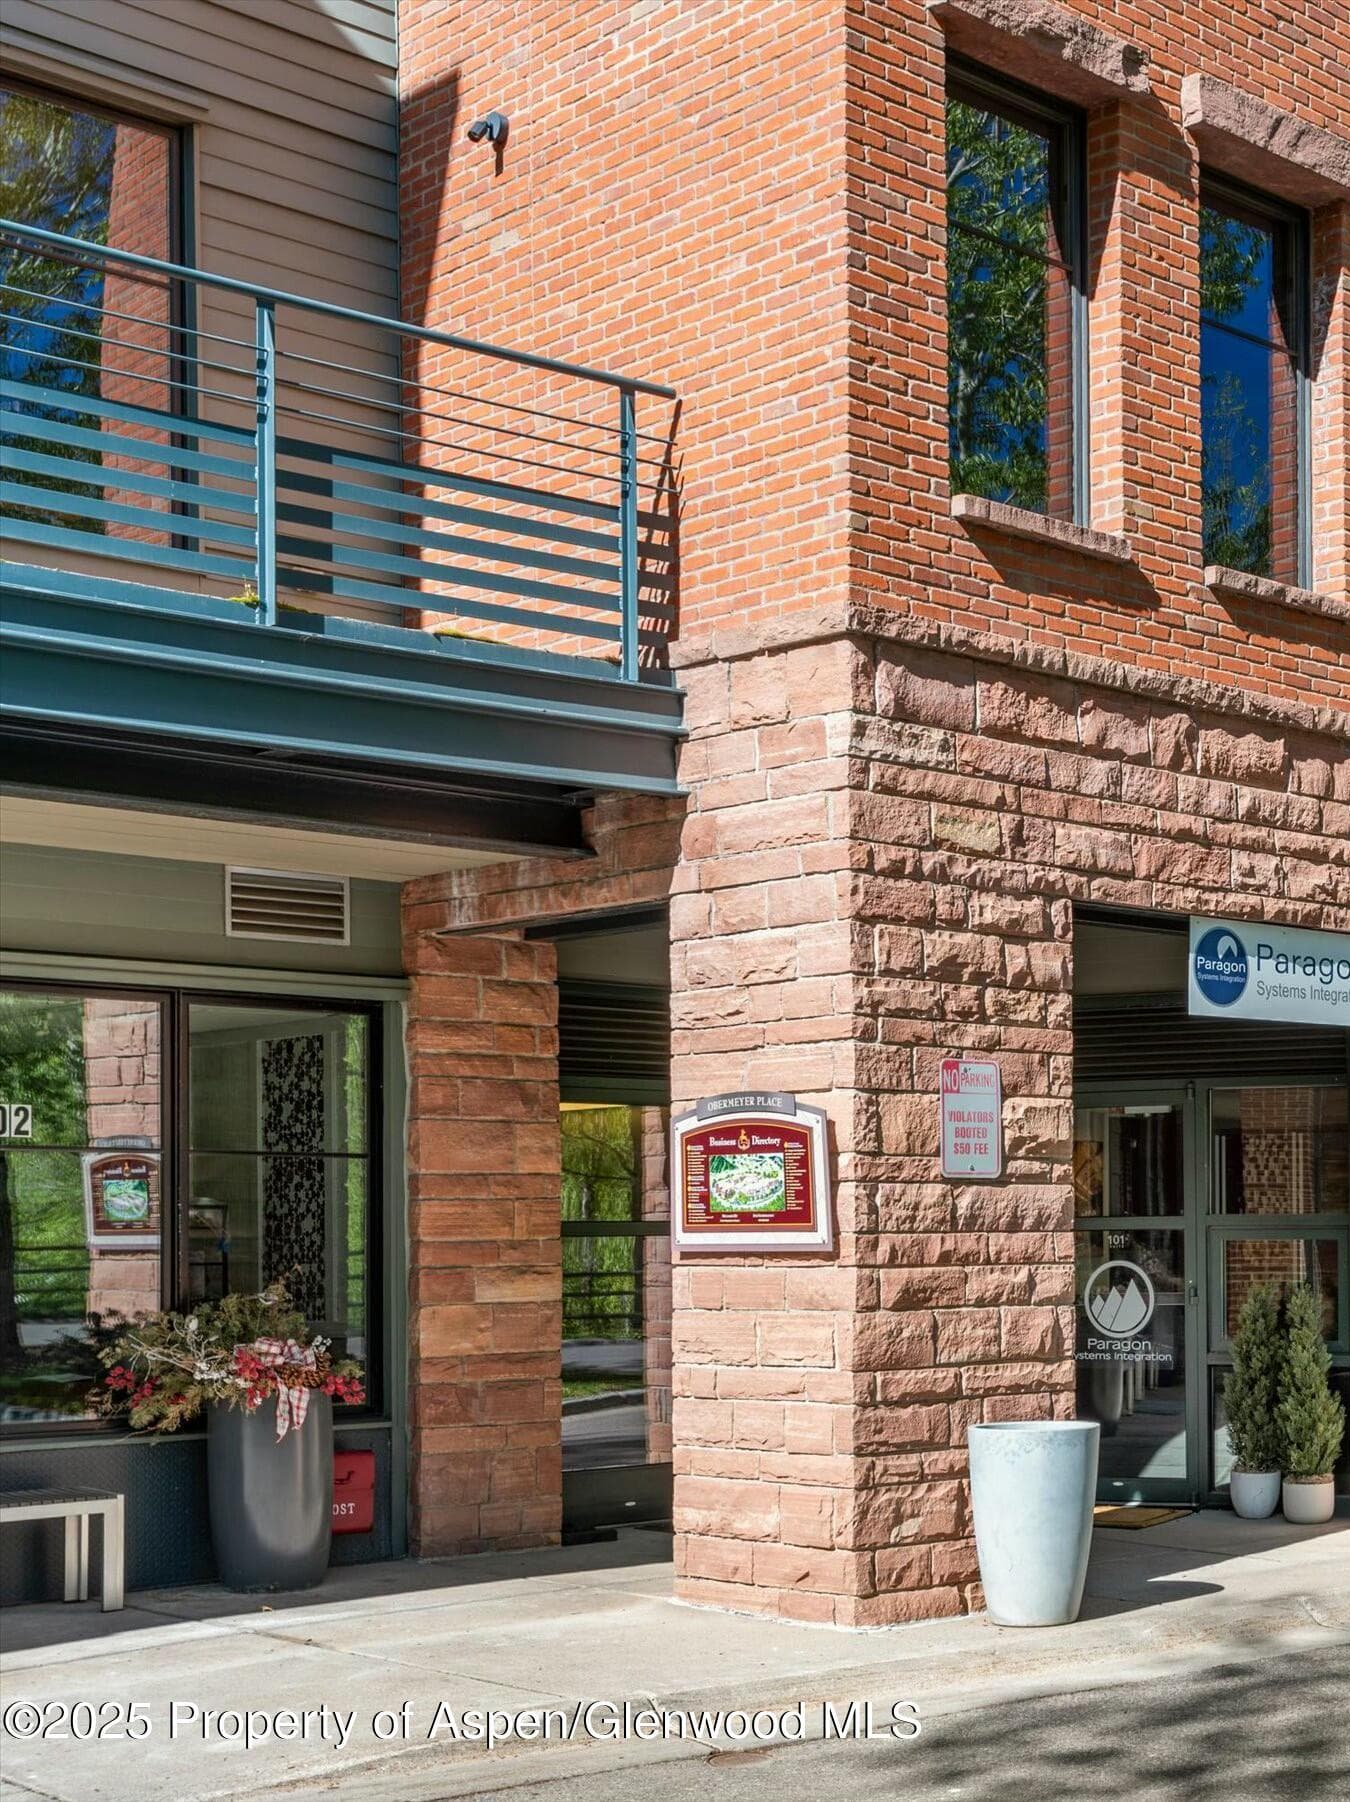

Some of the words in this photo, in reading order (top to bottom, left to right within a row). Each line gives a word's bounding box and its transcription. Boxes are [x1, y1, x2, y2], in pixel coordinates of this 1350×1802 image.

[1197, 956, 1246, 974] Paragon
[1256, 980, 1307, 1000] Systems
[943, 1068, 959, 1090] NO
[960, 1072, 995, 1088] PARKING
[707, 1096, 755, 1112] OBERMEYER
[757, 1096, 783, 1108] PLACE
[948, 1110, 994, 1123] VIOLATORS
[954, 1127, 988, 1139] BOOTED
[709, 1137, 737, 1147] Business
[751, 1135, 781, 1147] Directory
[953, 1142, 971, 1155] $50
[974, 1143, 989, 1155] FEE
[1107, 1234, 1125, 1245] 101
[1087, 1338, 1152, 1352] Paragon
[1073, 1351, 1111, 1361] ystems
[1114, 1351, 1172, 1362] Integration
[332, 1502, 355, 1516] OST
